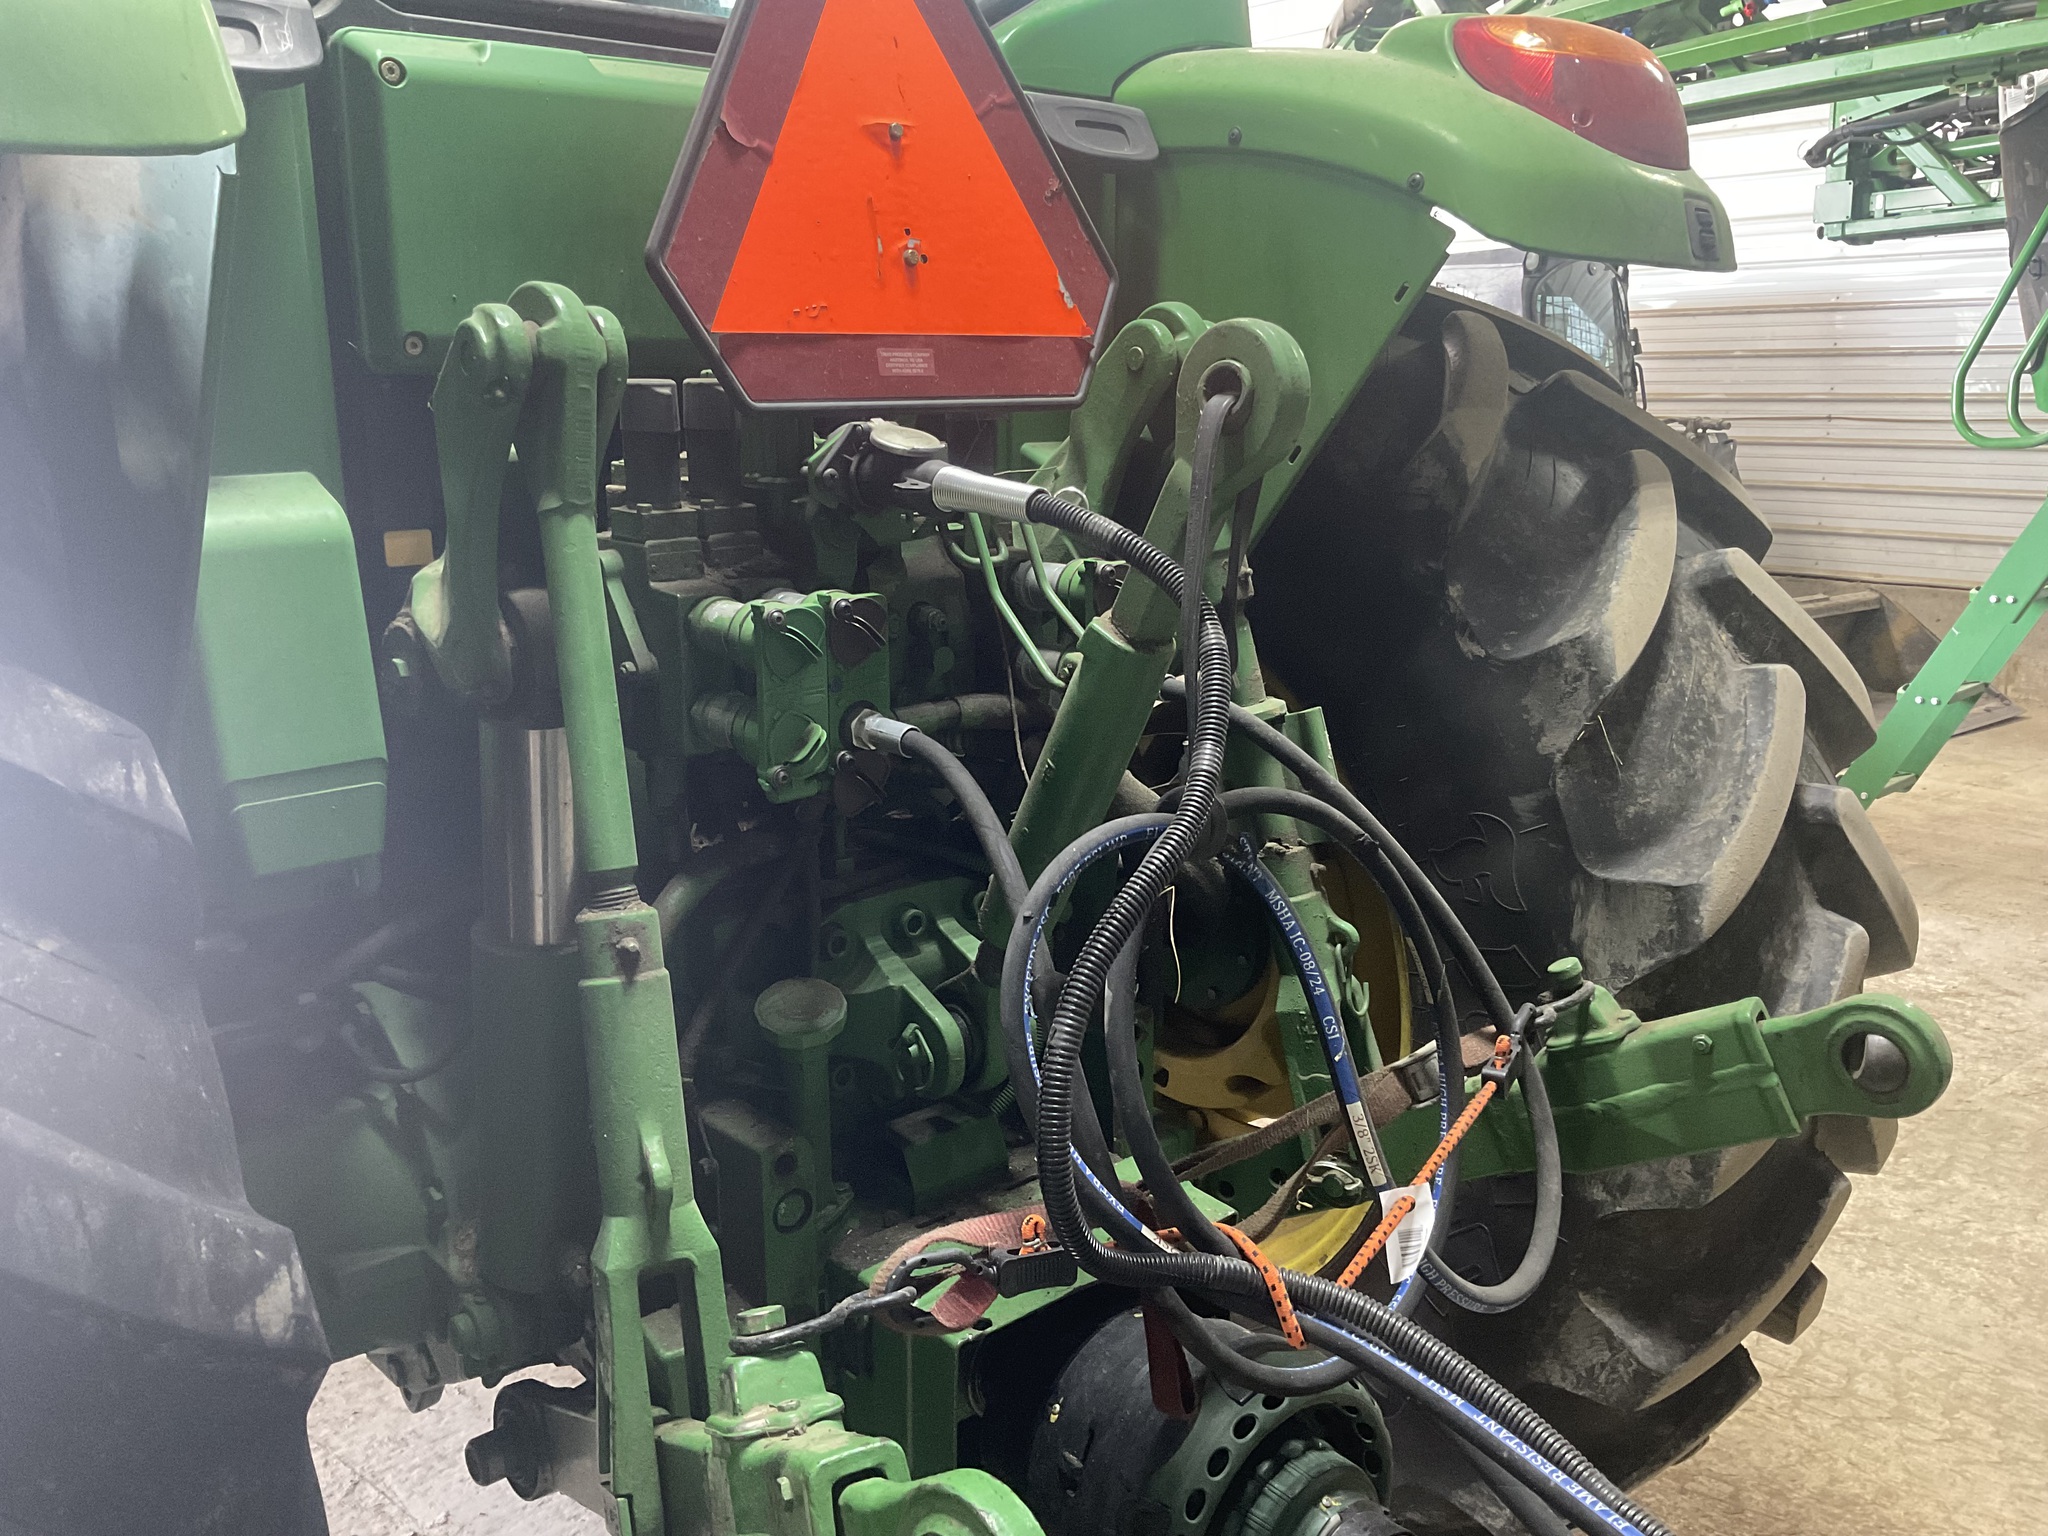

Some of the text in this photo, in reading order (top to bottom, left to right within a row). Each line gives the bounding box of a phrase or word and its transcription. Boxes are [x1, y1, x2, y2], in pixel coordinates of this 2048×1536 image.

[1264, 887, 1297, 932] MSHA
[1289, 931, 1326, 996] IC-08/24
[1322, 1014, 1341, 1040] CSI
[1352, 1113, 1382, 1175] 3/8" 2SK
[1435, 1278, 1488, 1312] PRESSURE
[1472, 1412, 1569, 1483] RESISTANT
[1565, 1482, 1631, 1530] FLAME
